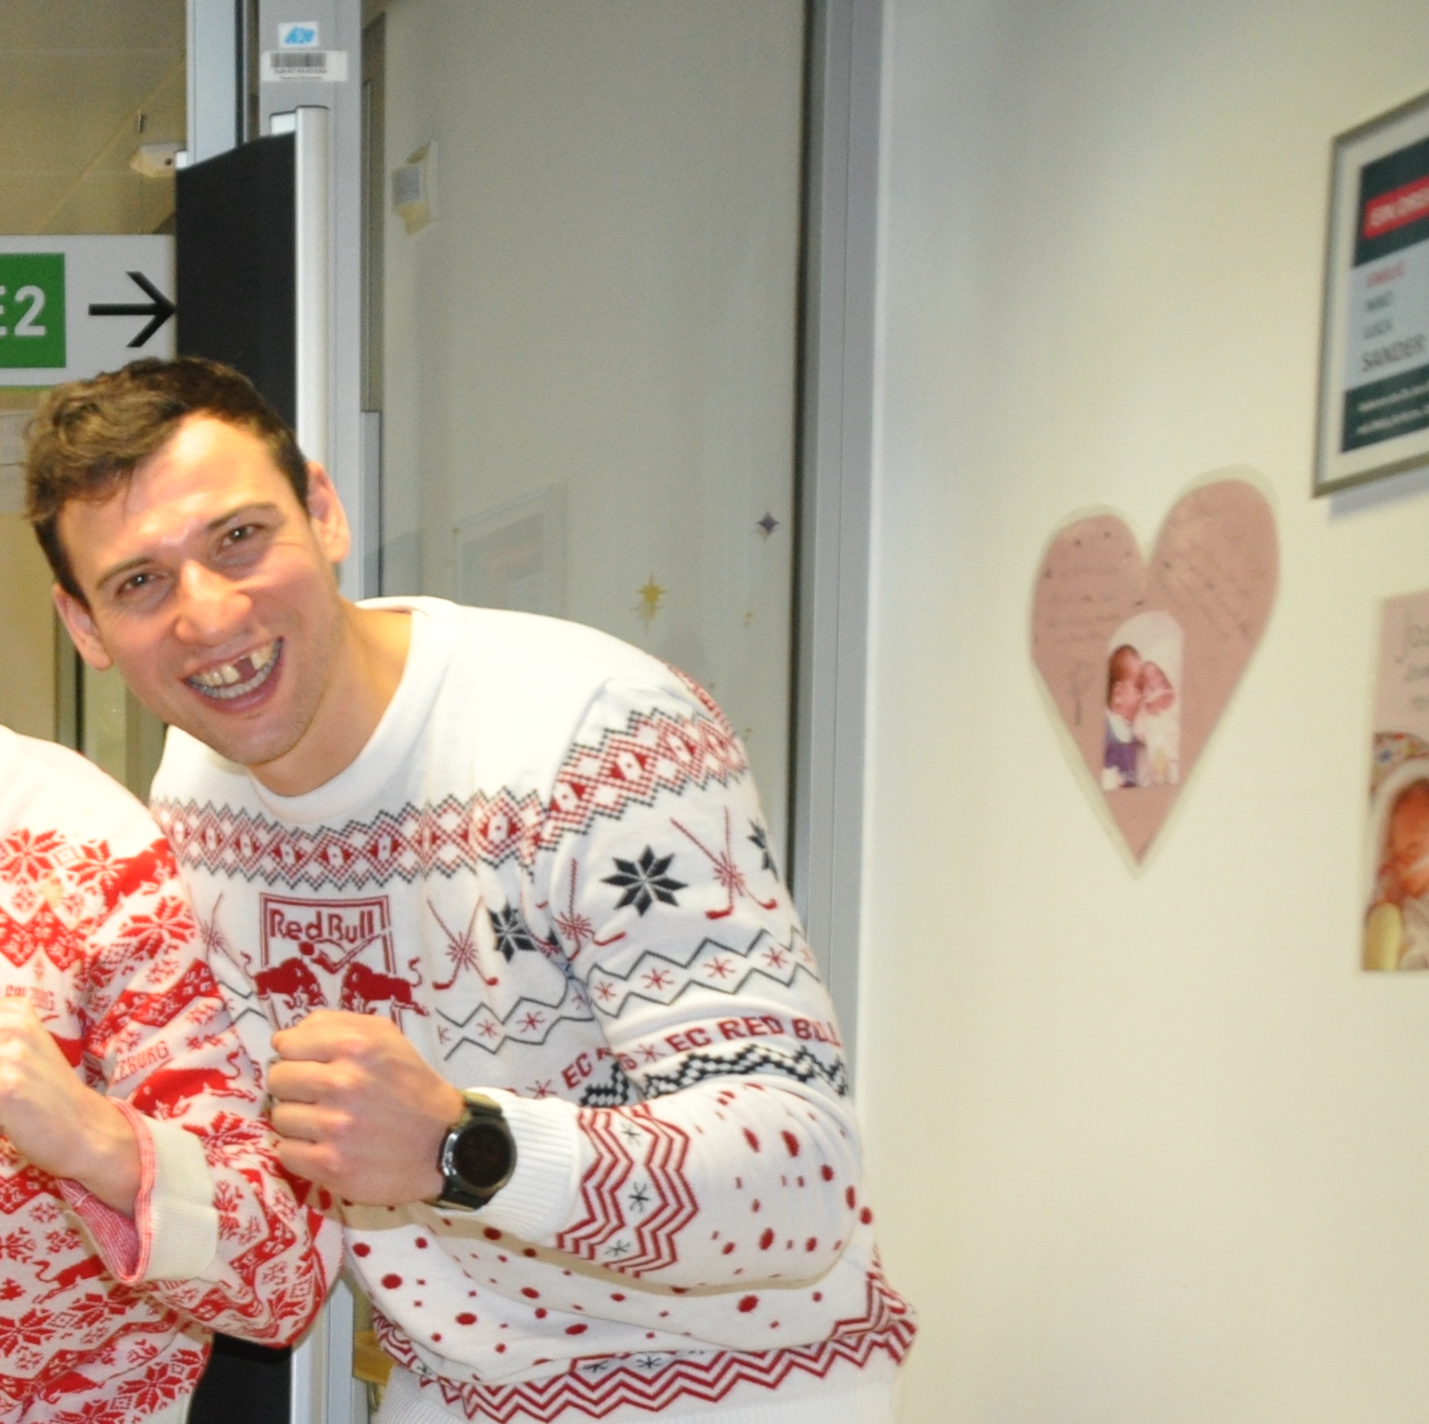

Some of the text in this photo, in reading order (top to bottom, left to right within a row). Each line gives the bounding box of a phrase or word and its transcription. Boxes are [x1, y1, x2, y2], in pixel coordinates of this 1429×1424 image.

[269, 907, 375, 944] Red Bull
[664, 1026, 714, 1053] EC
[715, 1014, 785, 1041] RED
